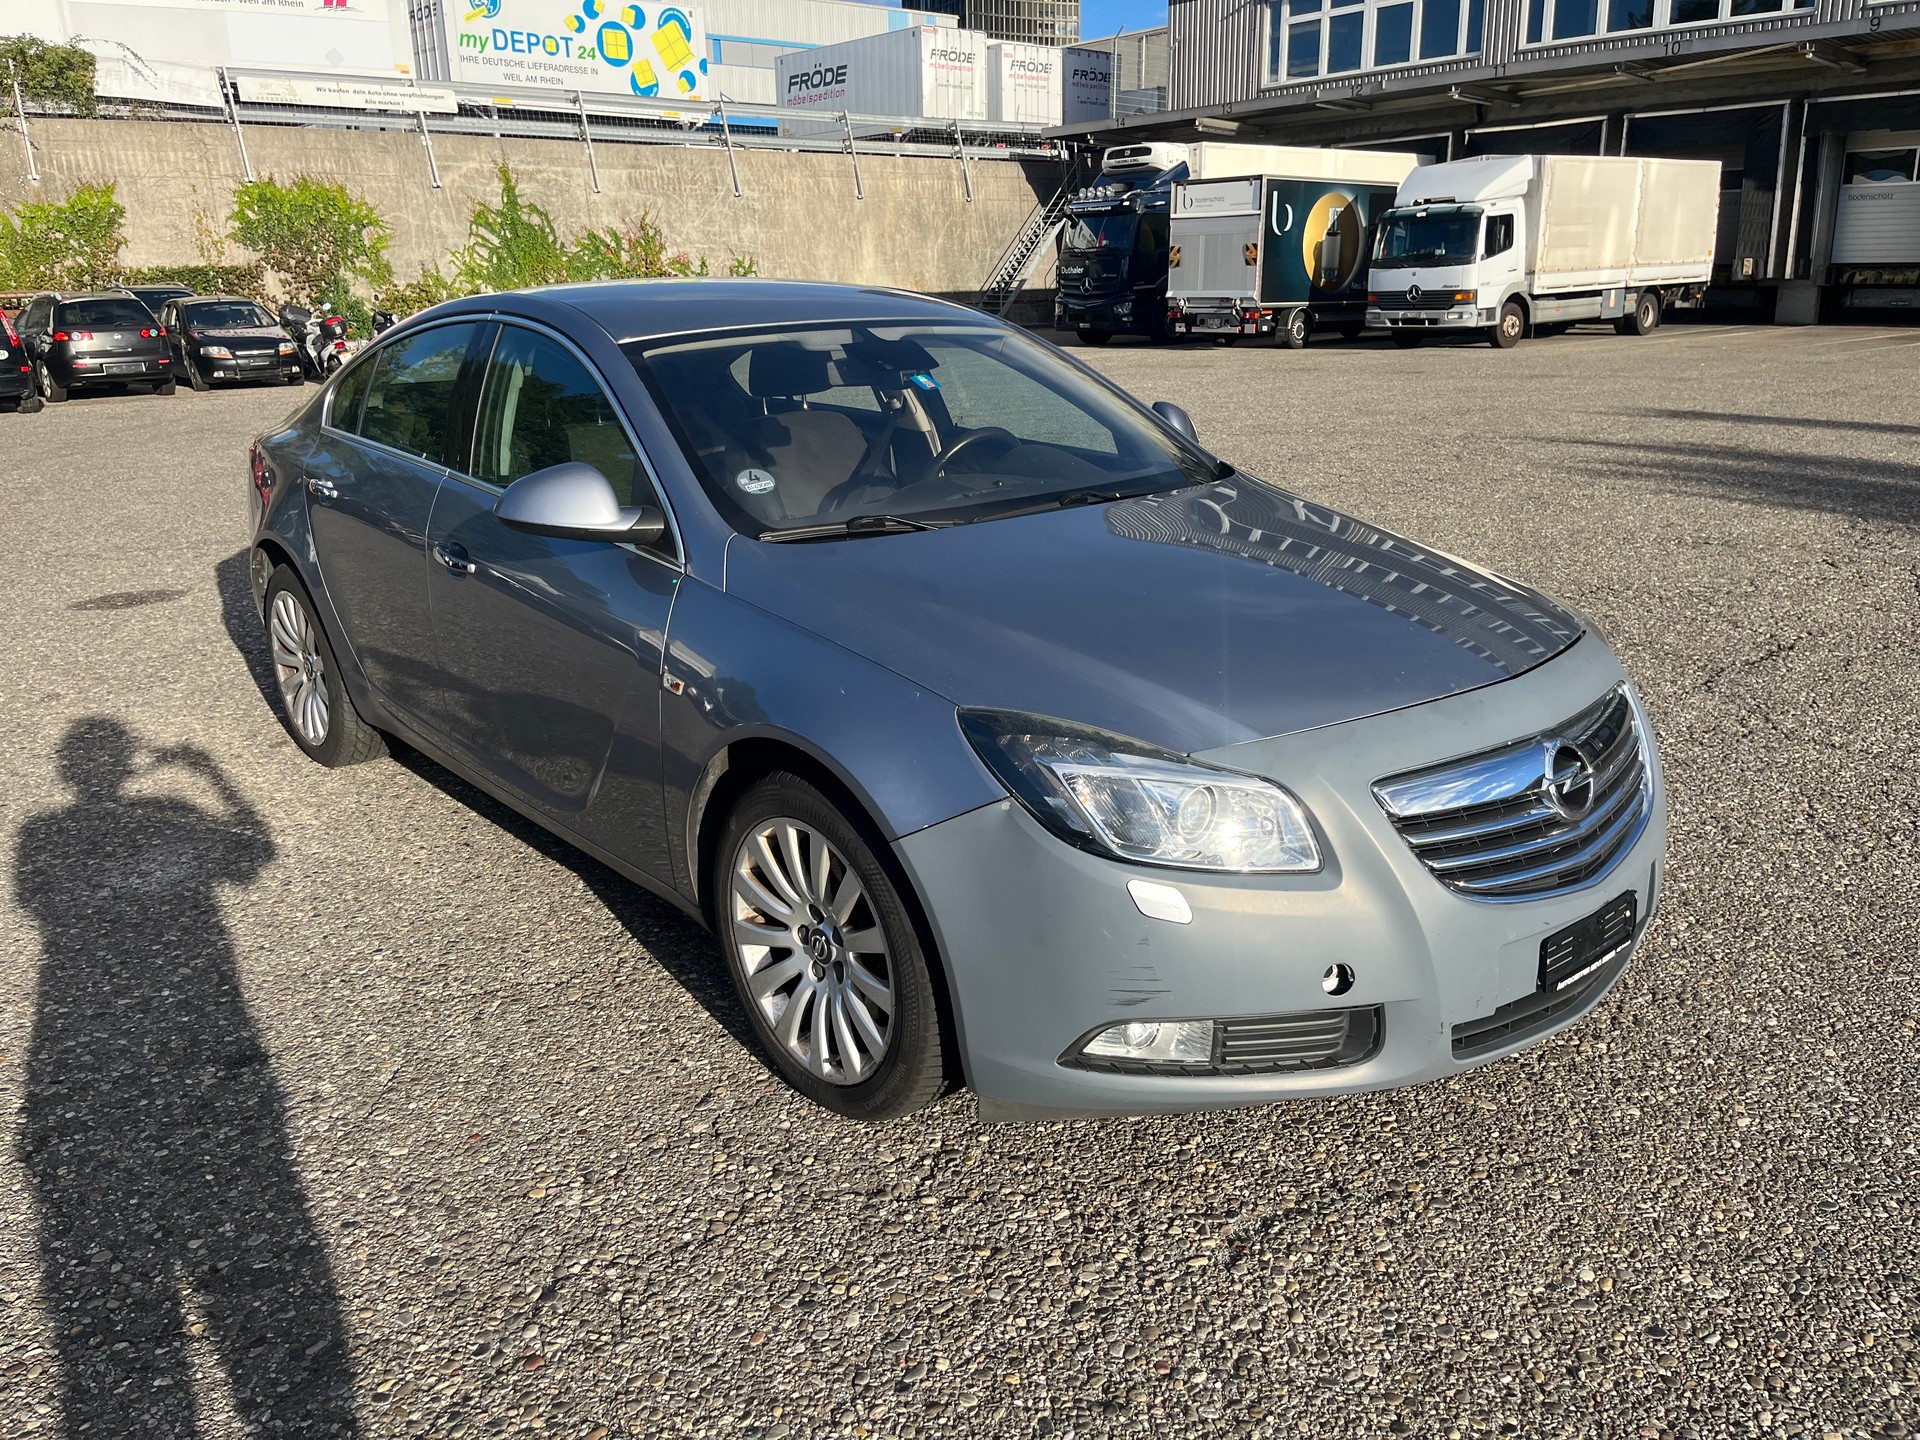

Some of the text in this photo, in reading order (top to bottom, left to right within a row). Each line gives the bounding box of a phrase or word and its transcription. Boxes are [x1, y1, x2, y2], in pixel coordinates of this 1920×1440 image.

[278, 0, 304, 8] Rhein
[1870, 16, 1880, 31] 9
[577, 46, 596, 60] 24
[930, 46, 976, 64] FRÖDE
[1663, 41, 1681, 56] 10
[460, 55, 599, 75] IHRE DEUTSCHE LIEFERADRESSE IN
[1010, 57, 1052, 74] FRÖDE
[503, 72, 564, 86] WEIL AM RHEIN
[788, 62, 848, 94] FRÖDE
[1072, 67, 1111, 84] FRÖDE
[787, 88, 846, 107] möbelspedition
[1350, 84, 1363, 97] 12
[1222, 102, 1233, 115] 13
[1116, 117, 1125, 128] 14
[1848, 192, 1894, 201] bodenschatz
[1061, 266, 1084, 274] Duthaler
